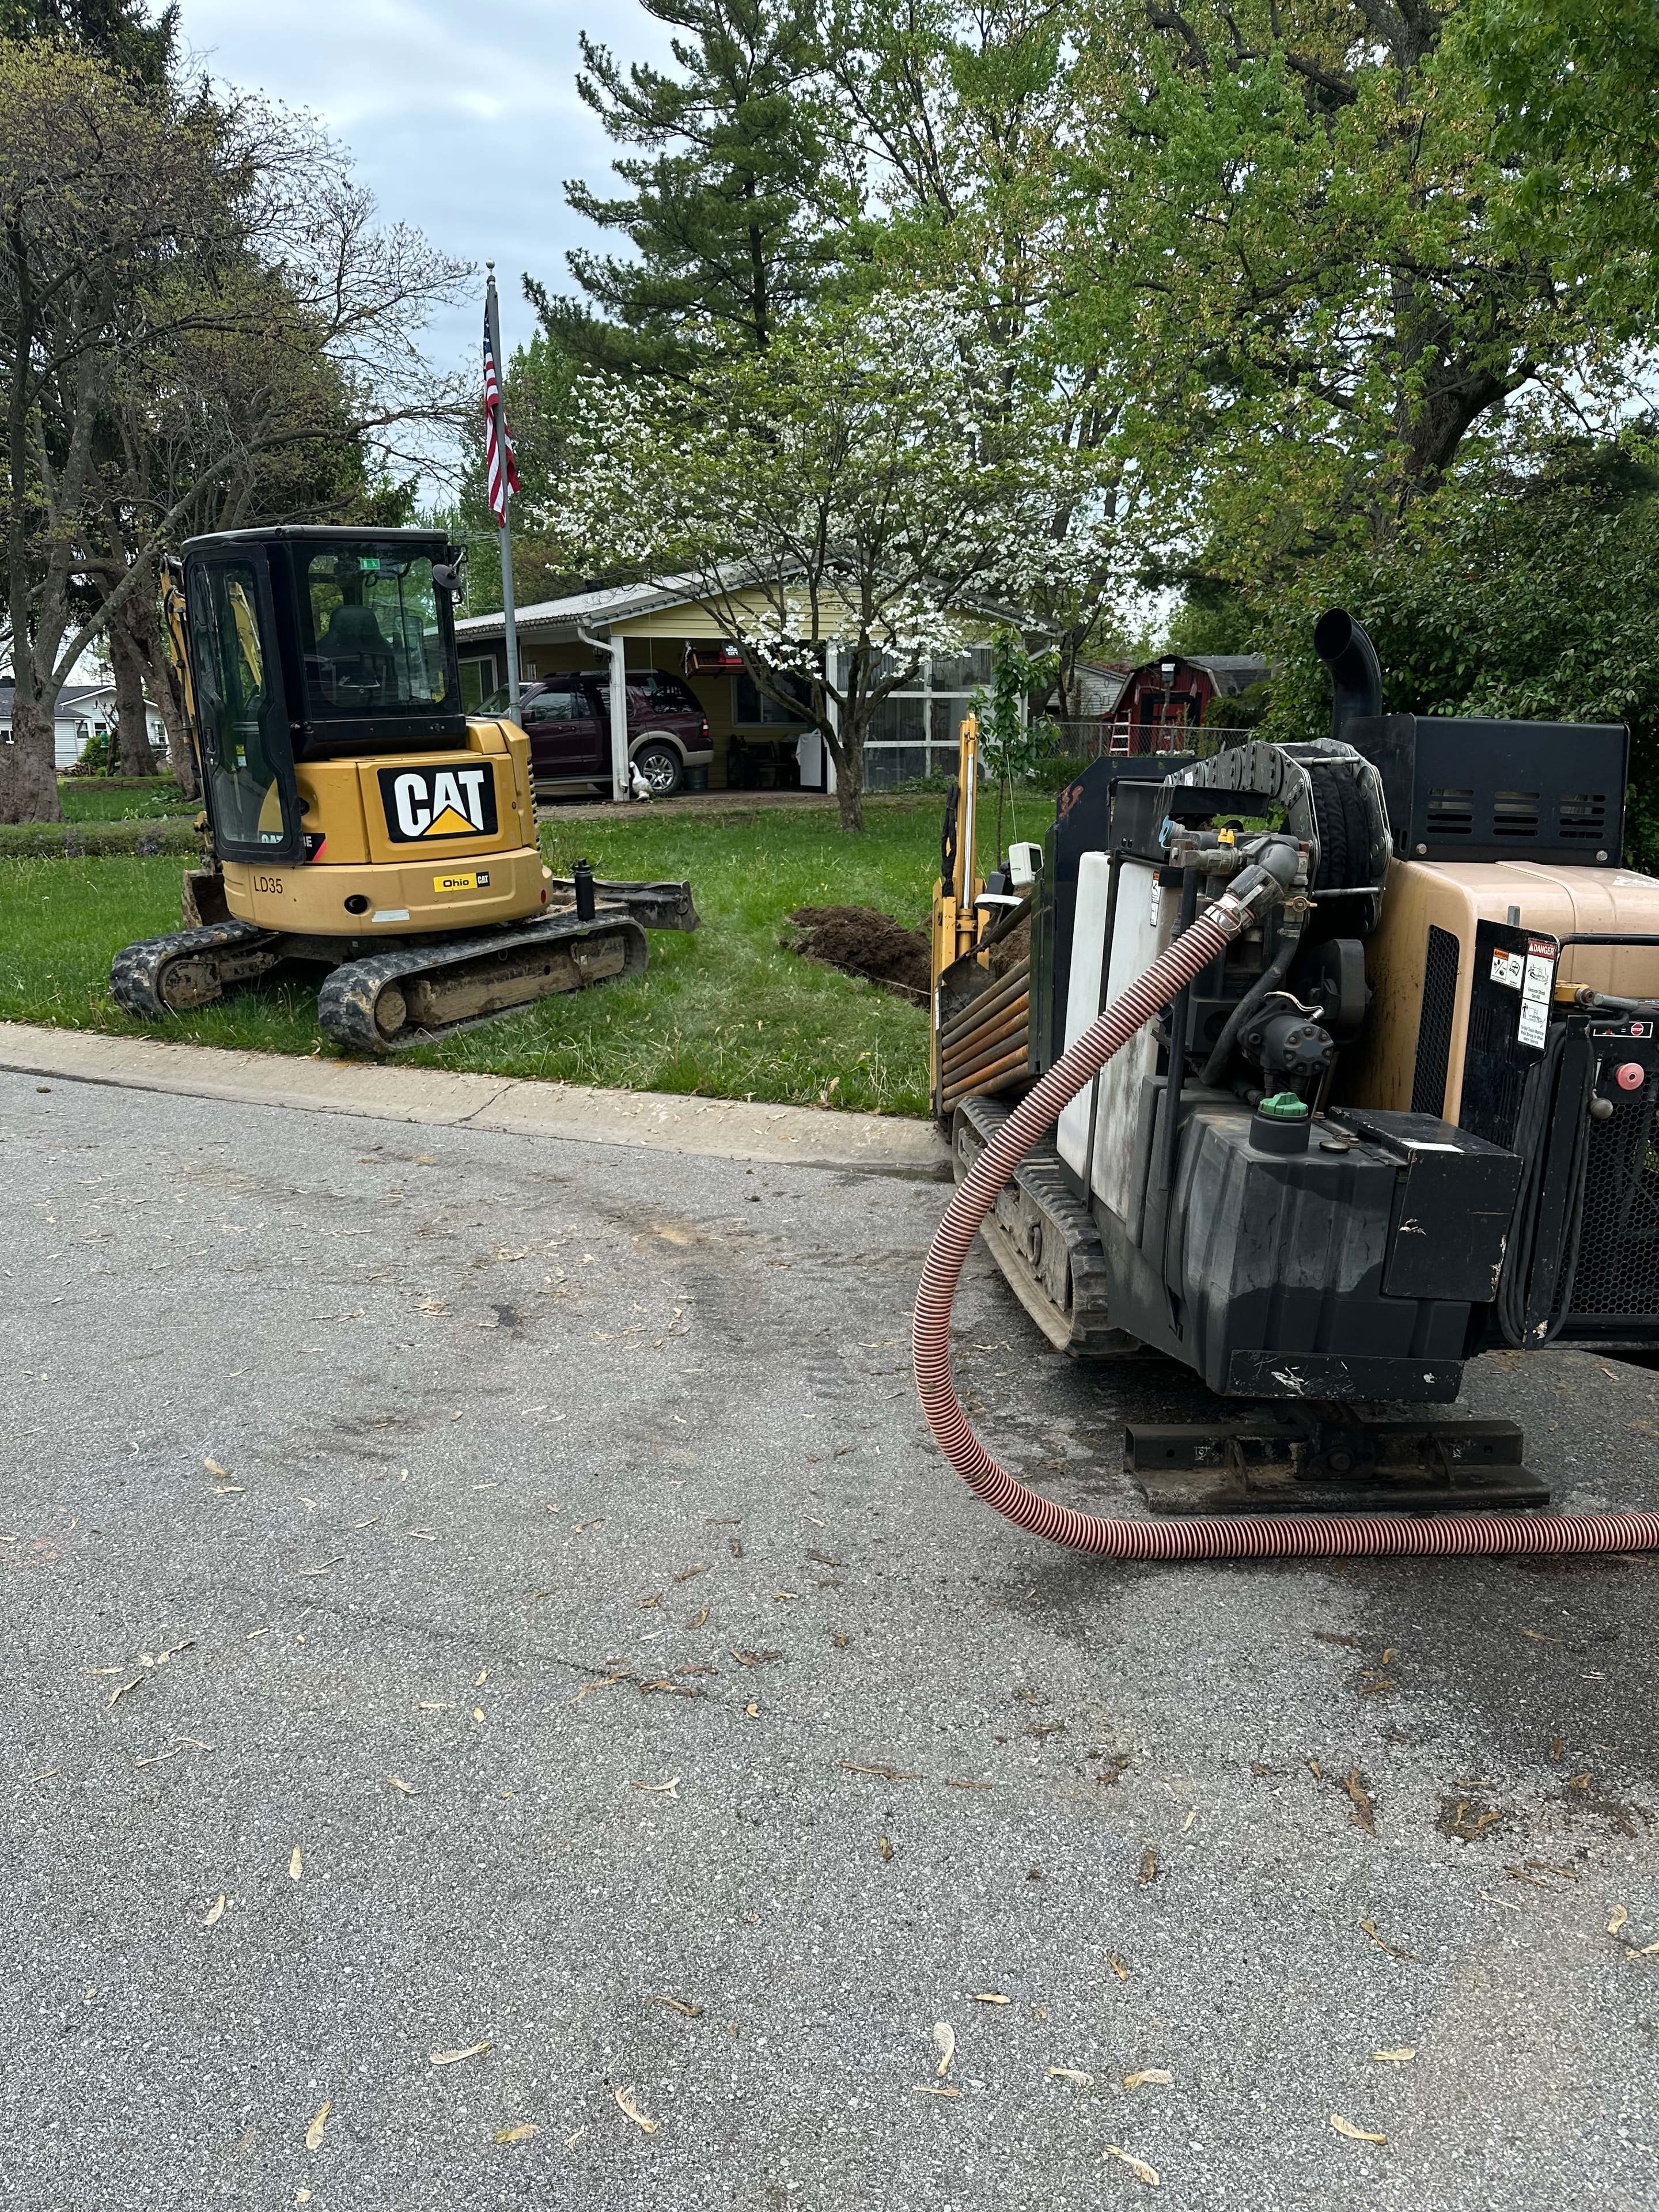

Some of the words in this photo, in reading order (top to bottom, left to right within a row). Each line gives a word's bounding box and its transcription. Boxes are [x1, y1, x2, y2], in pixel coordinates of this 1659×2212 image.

[394, 770, 484, 837] CAT
[443, 878, 469, 888] Ohio
[477, 875, 488, 884] CAT
[1533, 944, 1555, 956] DANGER
